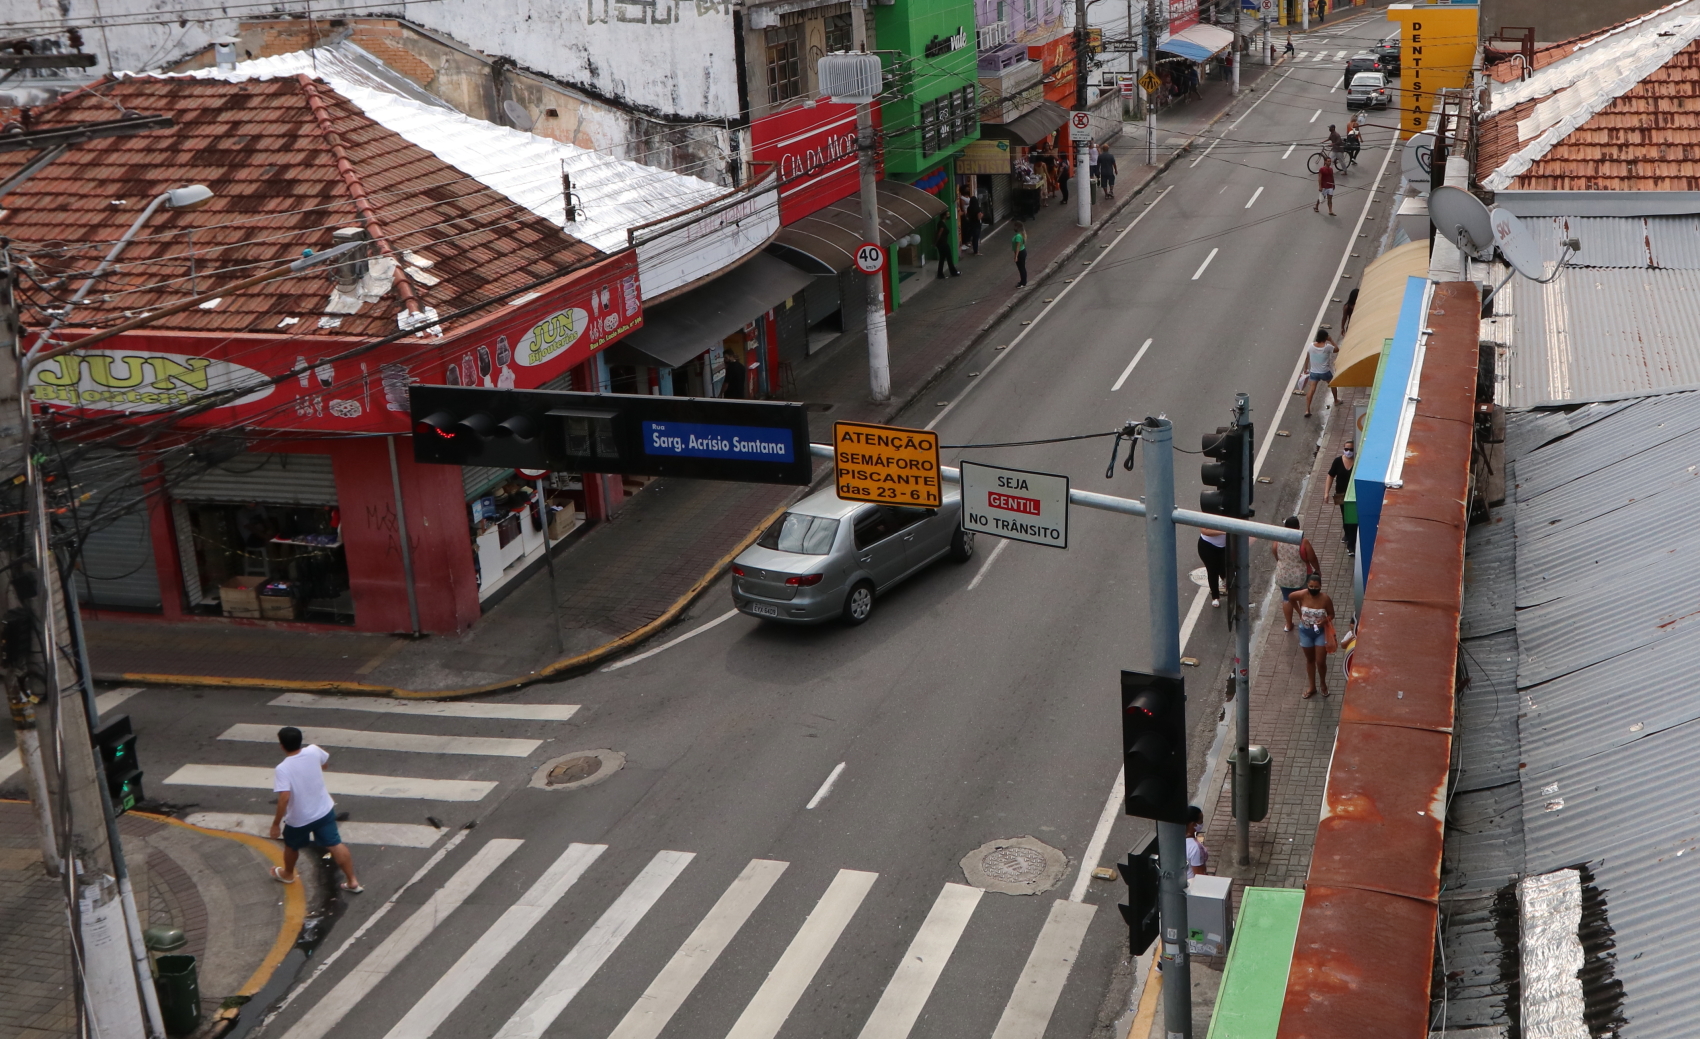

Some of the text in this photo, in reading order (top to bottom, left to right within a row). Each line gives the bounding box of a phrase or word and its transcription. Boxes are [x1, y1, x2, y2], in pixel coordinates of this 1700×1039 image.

[1412, 22, 1423, 126] DENTISTAS
[781, 133, 859, 182] CIA DA MOD
[956, 160, 1010, 174] DENTISTA
[1496, 217, 1512, 240] SKY
[859, 248, 879, 262] 40
[529, 308, 574, 352] JUN
[528, 330, 578, 365] Bijouterias
[37, 354, 212, 391] JUN
[652, 432, 786, 455] Sarg. Acrísio Santana
[840, 431, 933, 452] ATENÇÃO
[840, 452, 934, 472] SEMÁFORO
[838, 468, 936, 486] PISCANTE
[998, 476, 1029, 491] SEJA
[840, 483, 871, 496] das
[876, 486, 897, 498] 23
[910, 490, 920, 500] 6
[926, 490, 937, 502] h
[990, 494, 1038, 513] GENTIL
[969, 512, 1060, 540] NO TRÂNSITO
